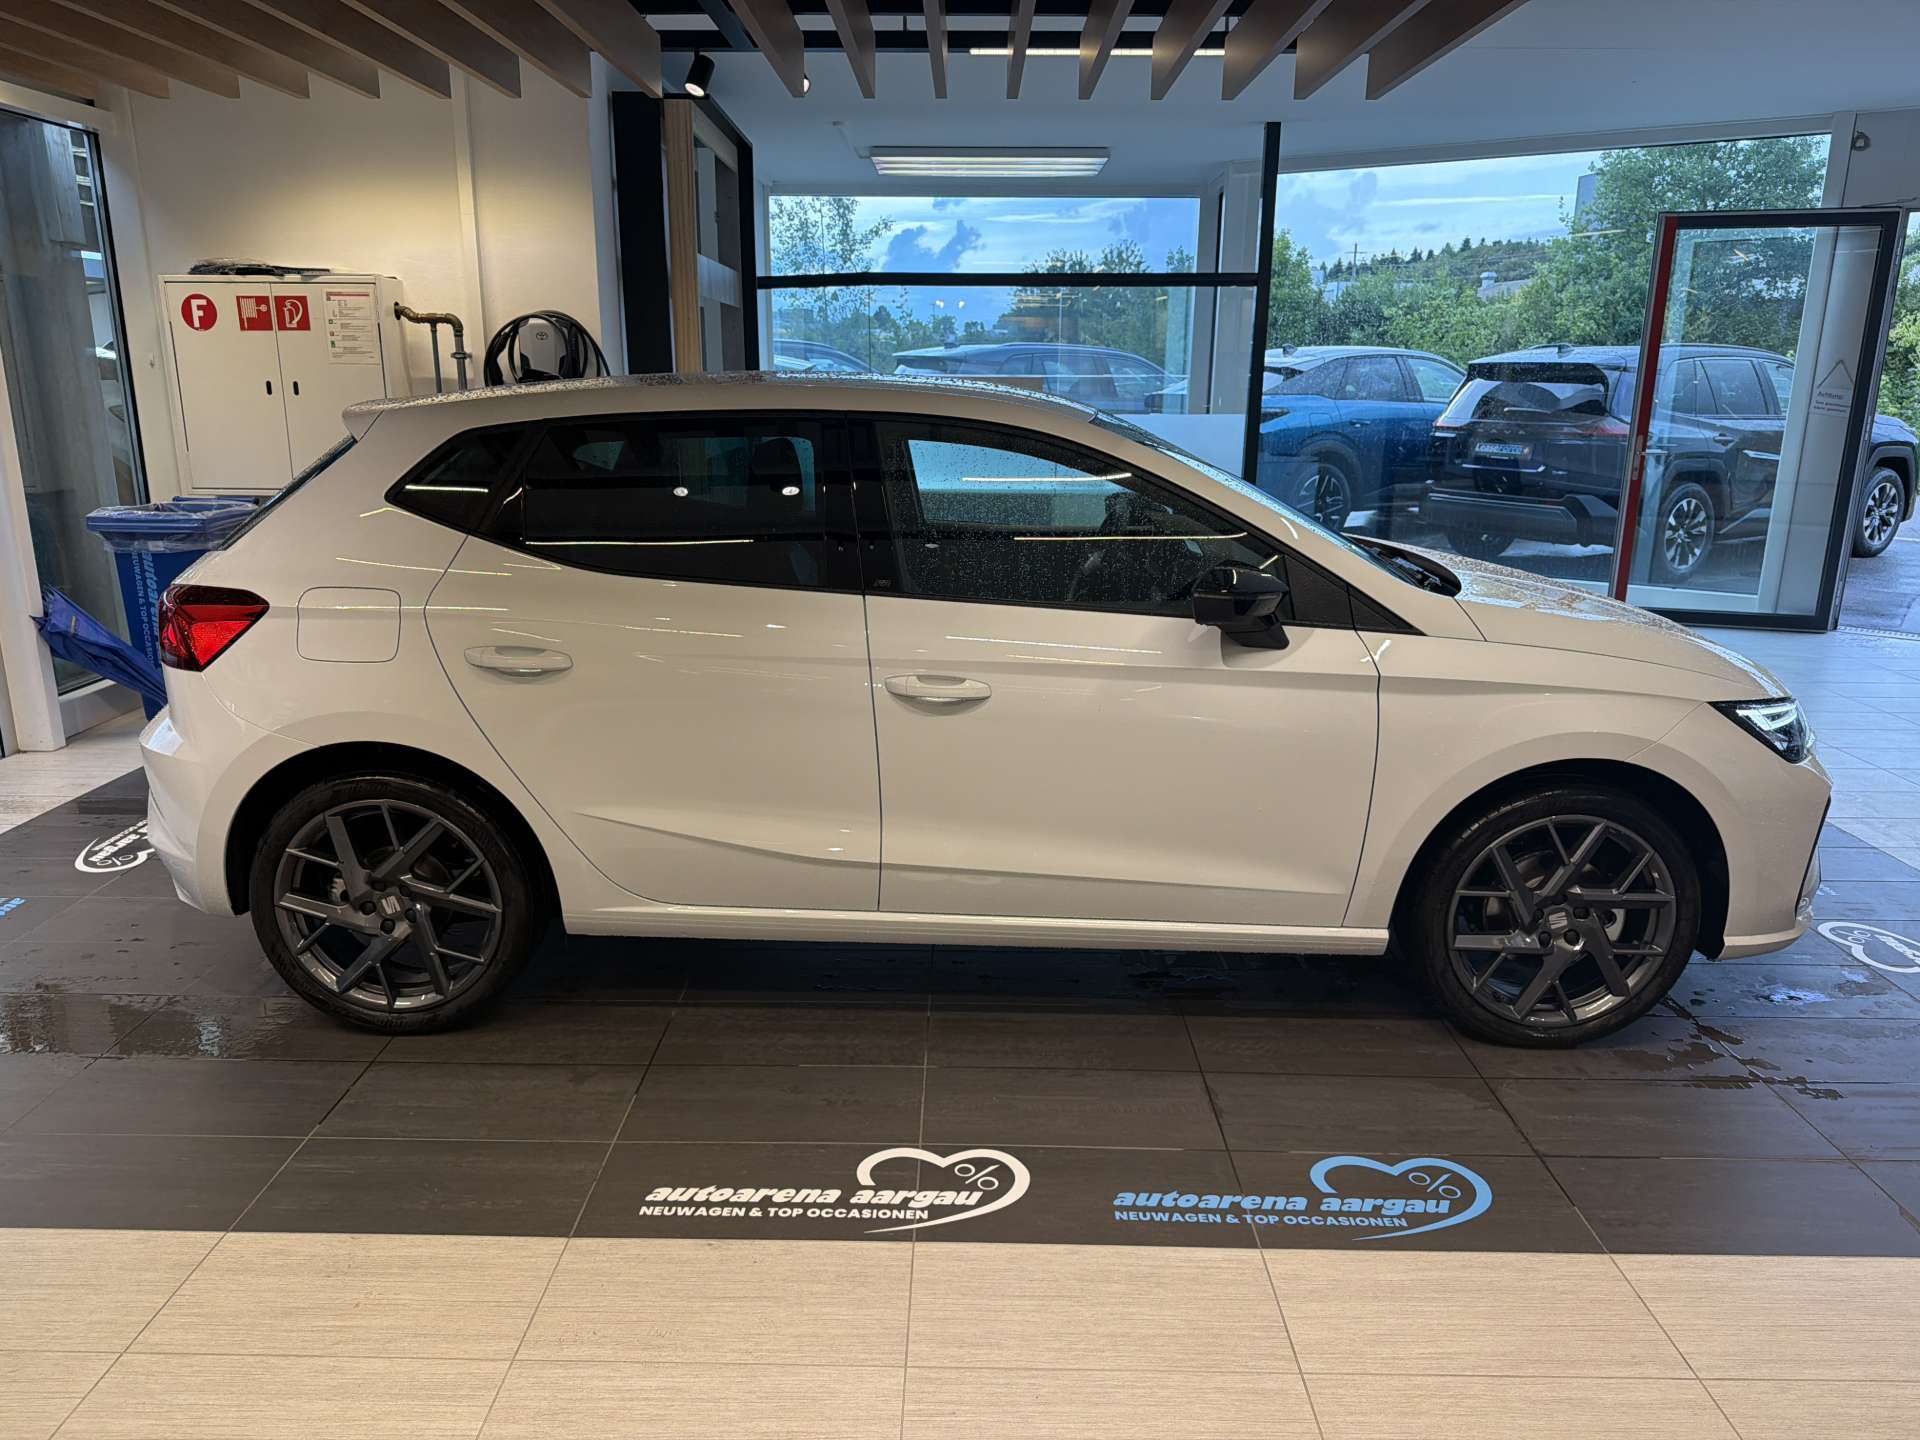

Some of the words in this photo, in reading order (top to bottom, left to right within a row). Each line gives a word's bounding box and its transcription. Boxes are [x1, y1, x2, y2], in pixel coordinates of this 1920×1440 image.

[190, 299, 208, 328] F
[645, 1184, 842, 1204] autoarena
[849, 1189, 983, 1208] aargau
[1113, 1190, 1308, 1211] autoarena
[1319, 1196, 1451, 1216] aargau
[638, 1206, 746, 1217] NEUWAGEN
[748, 1207, 763, 1217] &
[767, 1207, 804, 1218] TOP
[806, 1208, 929, 1220] OCCASIONEN
[1114, 1210, 1221, 1223] NEUWAGEN
[1225, 1214, 1240, 1224] &
[1243, 1214, 1280, 1225] TOP
[1283, 1215, 1409, 1227] OCCASIONEN
